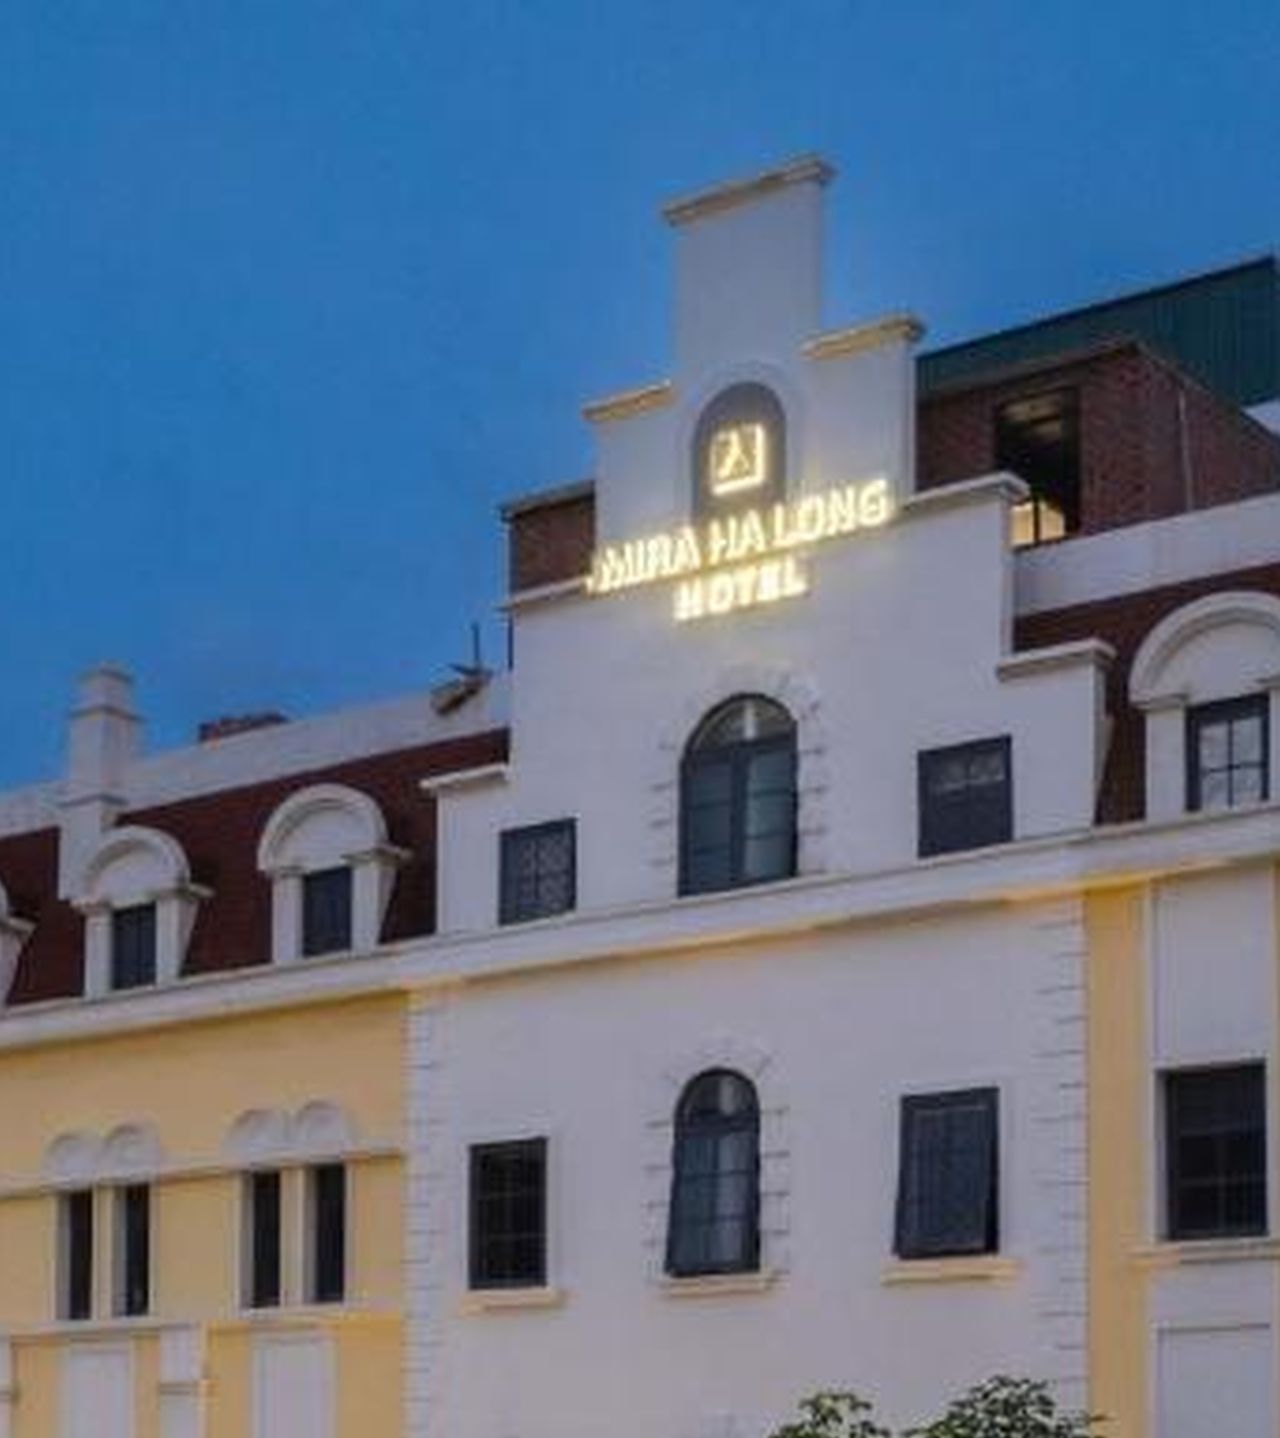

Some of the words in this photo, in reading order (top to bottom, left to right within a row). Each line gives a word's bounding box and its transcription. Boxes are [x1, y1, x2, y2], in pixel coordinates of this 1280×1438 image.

[587, 526, 702, 592] MIRA
[709, 510, 766, 564] HA
[773, 478, 890, 546] LONG
[674, 557, 806, 621] HOTEL
